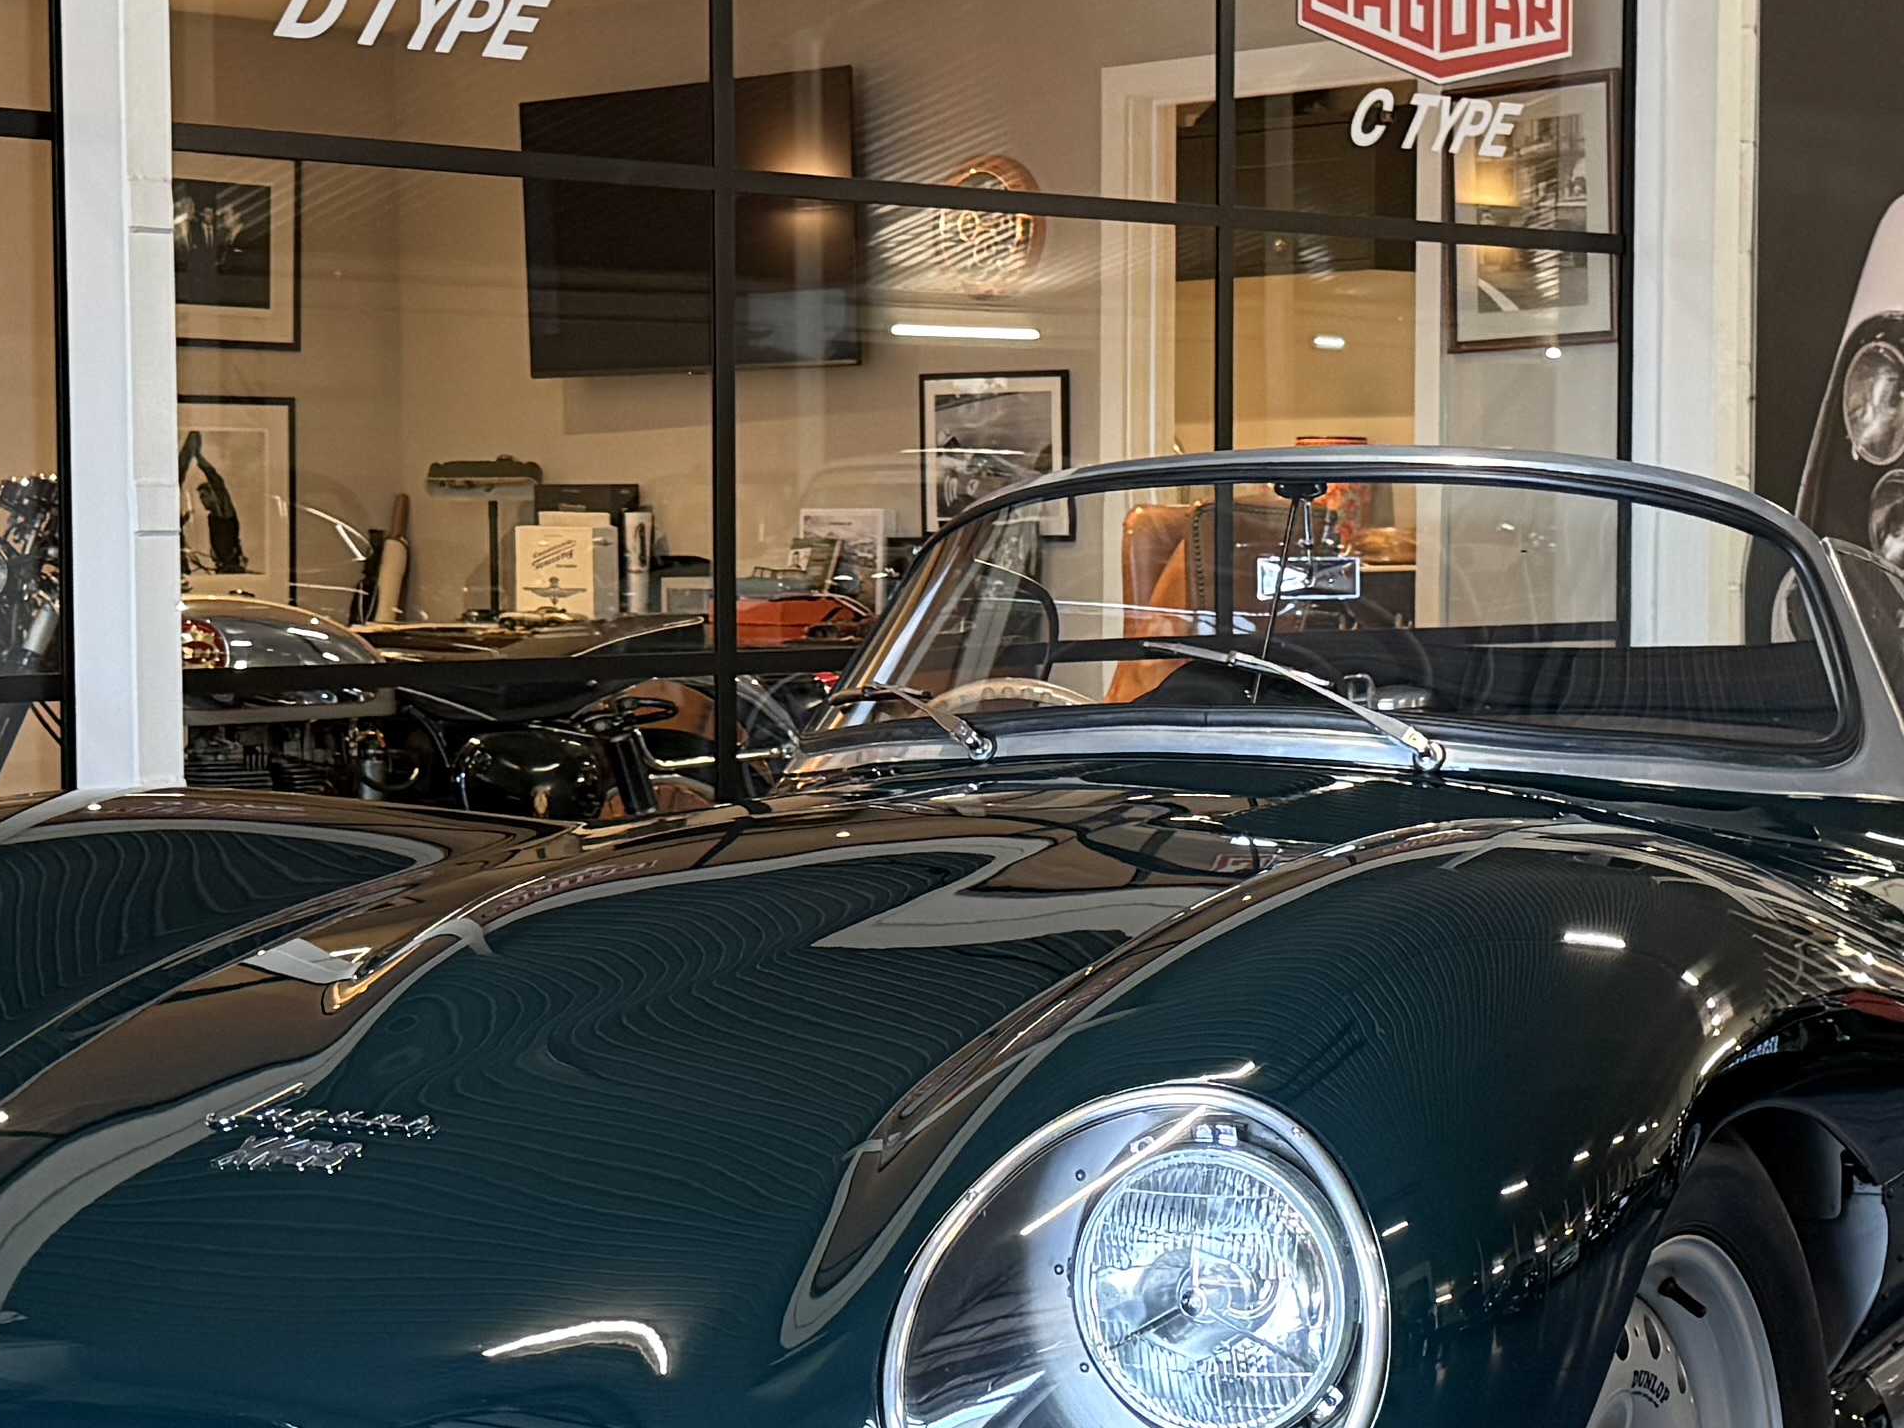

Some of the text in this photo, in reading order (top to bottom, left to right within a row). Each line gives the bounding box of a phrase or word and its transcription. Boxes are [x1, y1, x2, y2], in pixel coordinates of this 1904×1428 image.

[1350, 88, 1525, 158] C TYPE
[1631, 1369, 1671, 1404] DUNLOP
